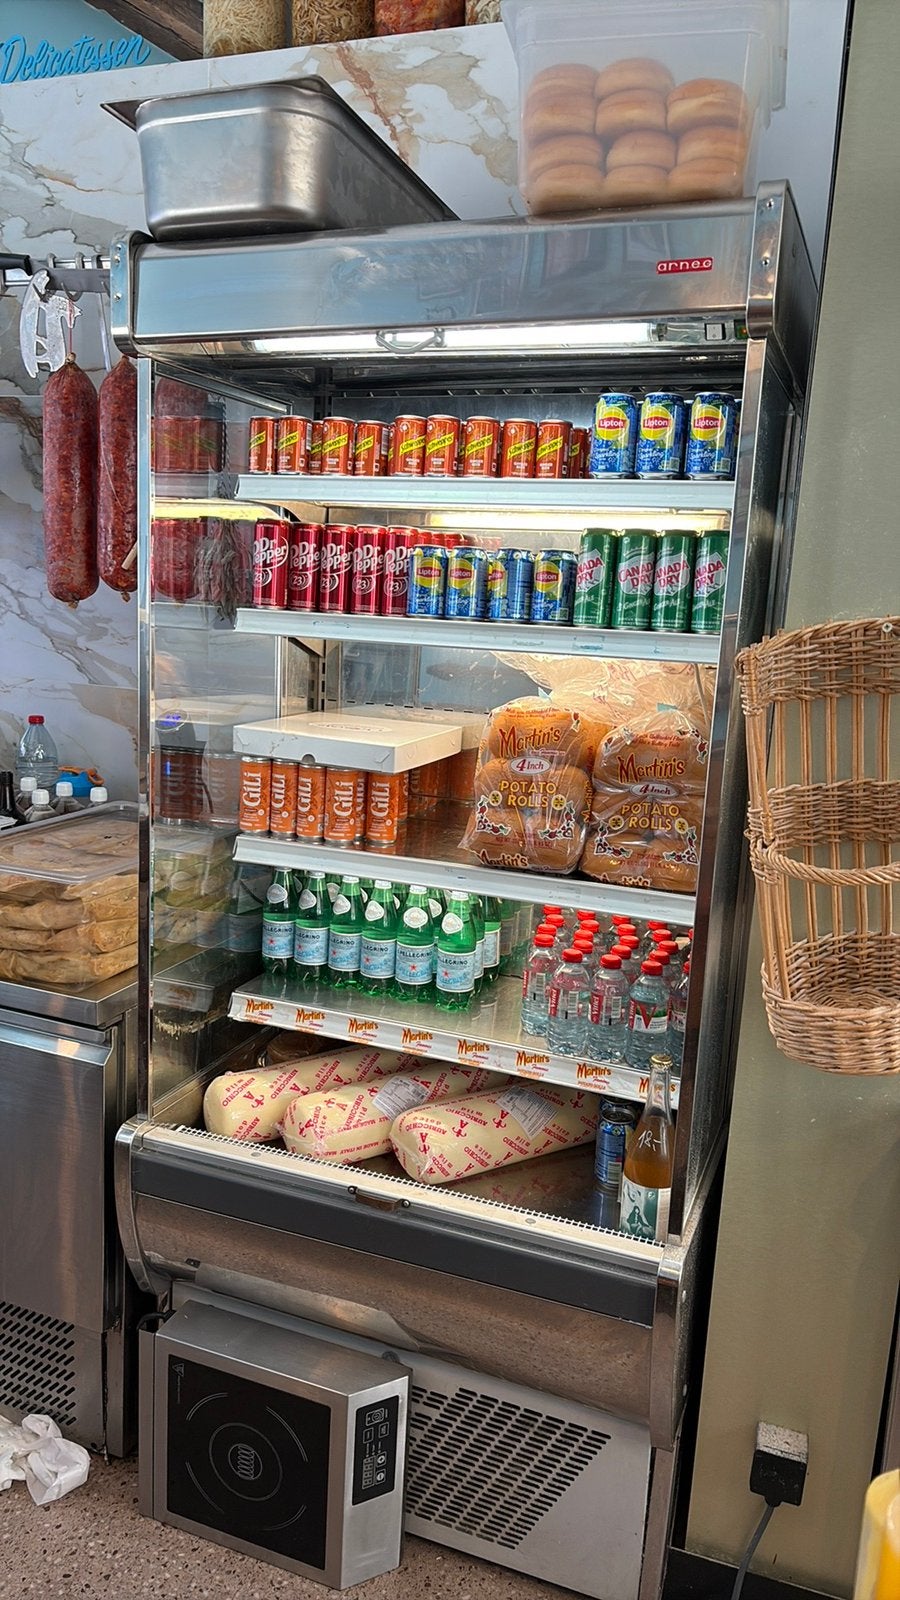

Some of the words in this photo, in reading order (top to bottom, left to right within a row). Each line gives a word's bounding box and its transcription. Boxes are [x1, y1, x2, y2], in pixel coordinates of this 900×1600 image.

[0, 34, 152, 84] Delicatessen
[600, 418, 624, 428] Lipton
[644, 418, 668, 427] Lipton
[695, 418, 720, 427] Lipton
[260, 537, 277, 552] Dr
[298, 541, 317, 556] Dr
[327, 543, 343, 558] Dr
[363, 544, 380, 559] Dr
[290, 544, 320, 569] Peppe
[353, 548, 384, 573] Peppe
[396, 546, 414, 560] Dr
[418, 569, 440, 577] Lipton
[577, 570, 594, 584] DRY
[618, 562, 653, 583] CANAD
[659, 573, 680, 587] DRY
[631, 574, 653, 588] DRY
[696, 574, 715, 589] DRY
[499, 726, 561, 758] Martin's
[516, 759, 526, 771] 4
[527, 761, 544, 770] Inch
[617, 754, 685, 783] Martin's
[500, 780, 557, 794] POTATO
[640, 784, 649, 794] 4
[333, 782, 353, 816] GiLi
[371, 782, 390, 817] GiLi
[507, 794, 549, 808] ROLLS
[621, 803, 680, 817] POTATO
[629, 817, 672, 831] ROLLS
[246, 999, 275, 1013] Martin's
[295, 1008, 326, 1023] Martin's
[348, 1018, 379, 1034] Martin's
[402, 1027, 433, 1044] Martin's
[458, 1039, 490, 1055] Martin's
[516, 1050, 550, 1067] Martin's
[577, 1063, 612, 1079] Martin's
[446, 1108, 488, 1126] AURICCHIO
[405, 1122, 447, 1135] AURICCHIO
[363, 1141, 379, 1151] MADE
